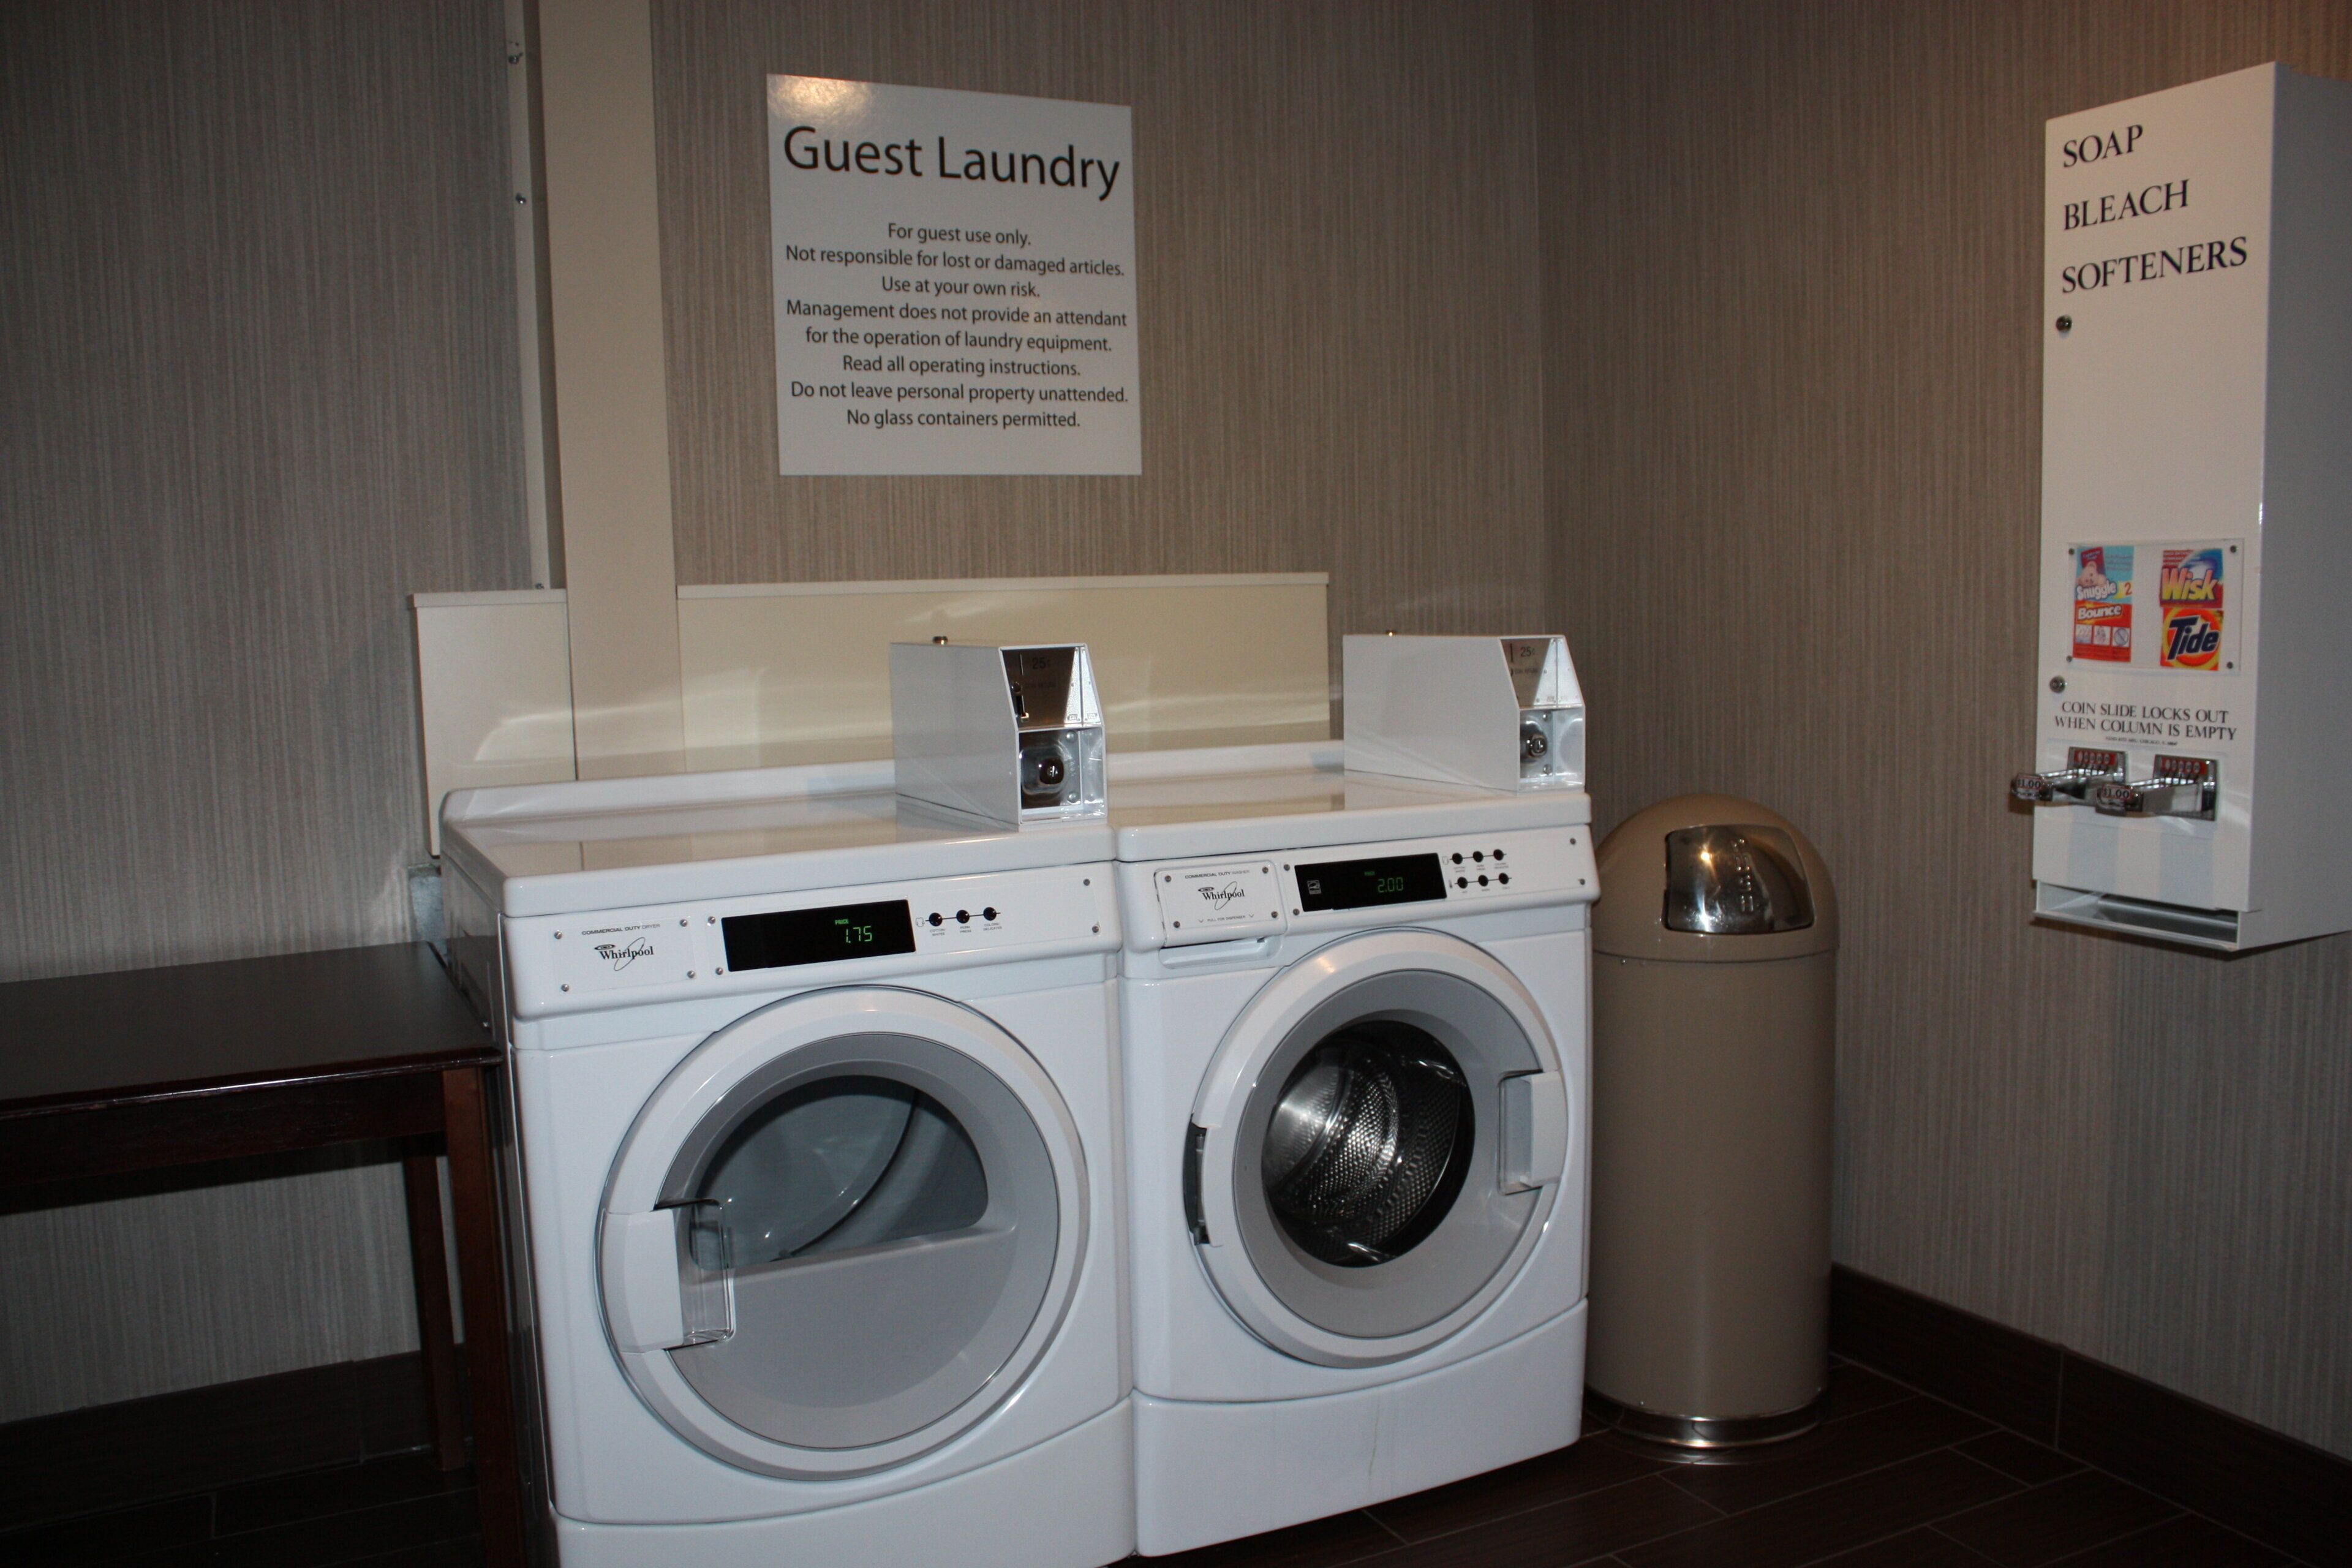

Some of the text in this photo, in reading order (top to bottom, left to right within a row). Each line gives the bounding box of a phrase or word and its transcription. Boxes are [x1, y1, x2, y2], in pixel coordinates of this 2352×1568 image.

[2063, 124, 2143, 168] SOAP
[785, 126, 1120, 201] Guest Laundry
[2064, 179, 2190, 230] BLEACH
[888, 223, 1031, 246] For guest use only.
[786, 246, 1125, 276] Not responsible for lost or damaged articles.
[2062, 236, 2248, 293] SOFTENERS
[882, 276, 1040, 297] Use at your own risk.
[787, 300, 1126, 326] Management does not provide an attendant
[805, 327, 1112, 352] for the operation of laundry equipment.
[843, 355, 1080, 377] Read all operating instructions.
[791, 382, 1128, 404] Do not leave personal property unattended.
[847, 410, 1080, 429] No glass containers permitted.
[2076, 579, 2117, 600] Snuggle
[2162, 567, 2217, 600] Wisk
[2078, 605, 2122, 620] Bounce
[2167, 616, 2220, 660] Tide
[2062, 701, 2229, 724] COIN SLIDE LOCKS OUT
[2055, 715, 2237, 741] WHEN COLUMN IS EMPTY
[1202, 889, 1245, 900] Whirlpool
[1378, 877, 1403, 892] 2.00
[846, 925, 872, 943] 1.75
[599, 946, 654, 960] Whirlpool
